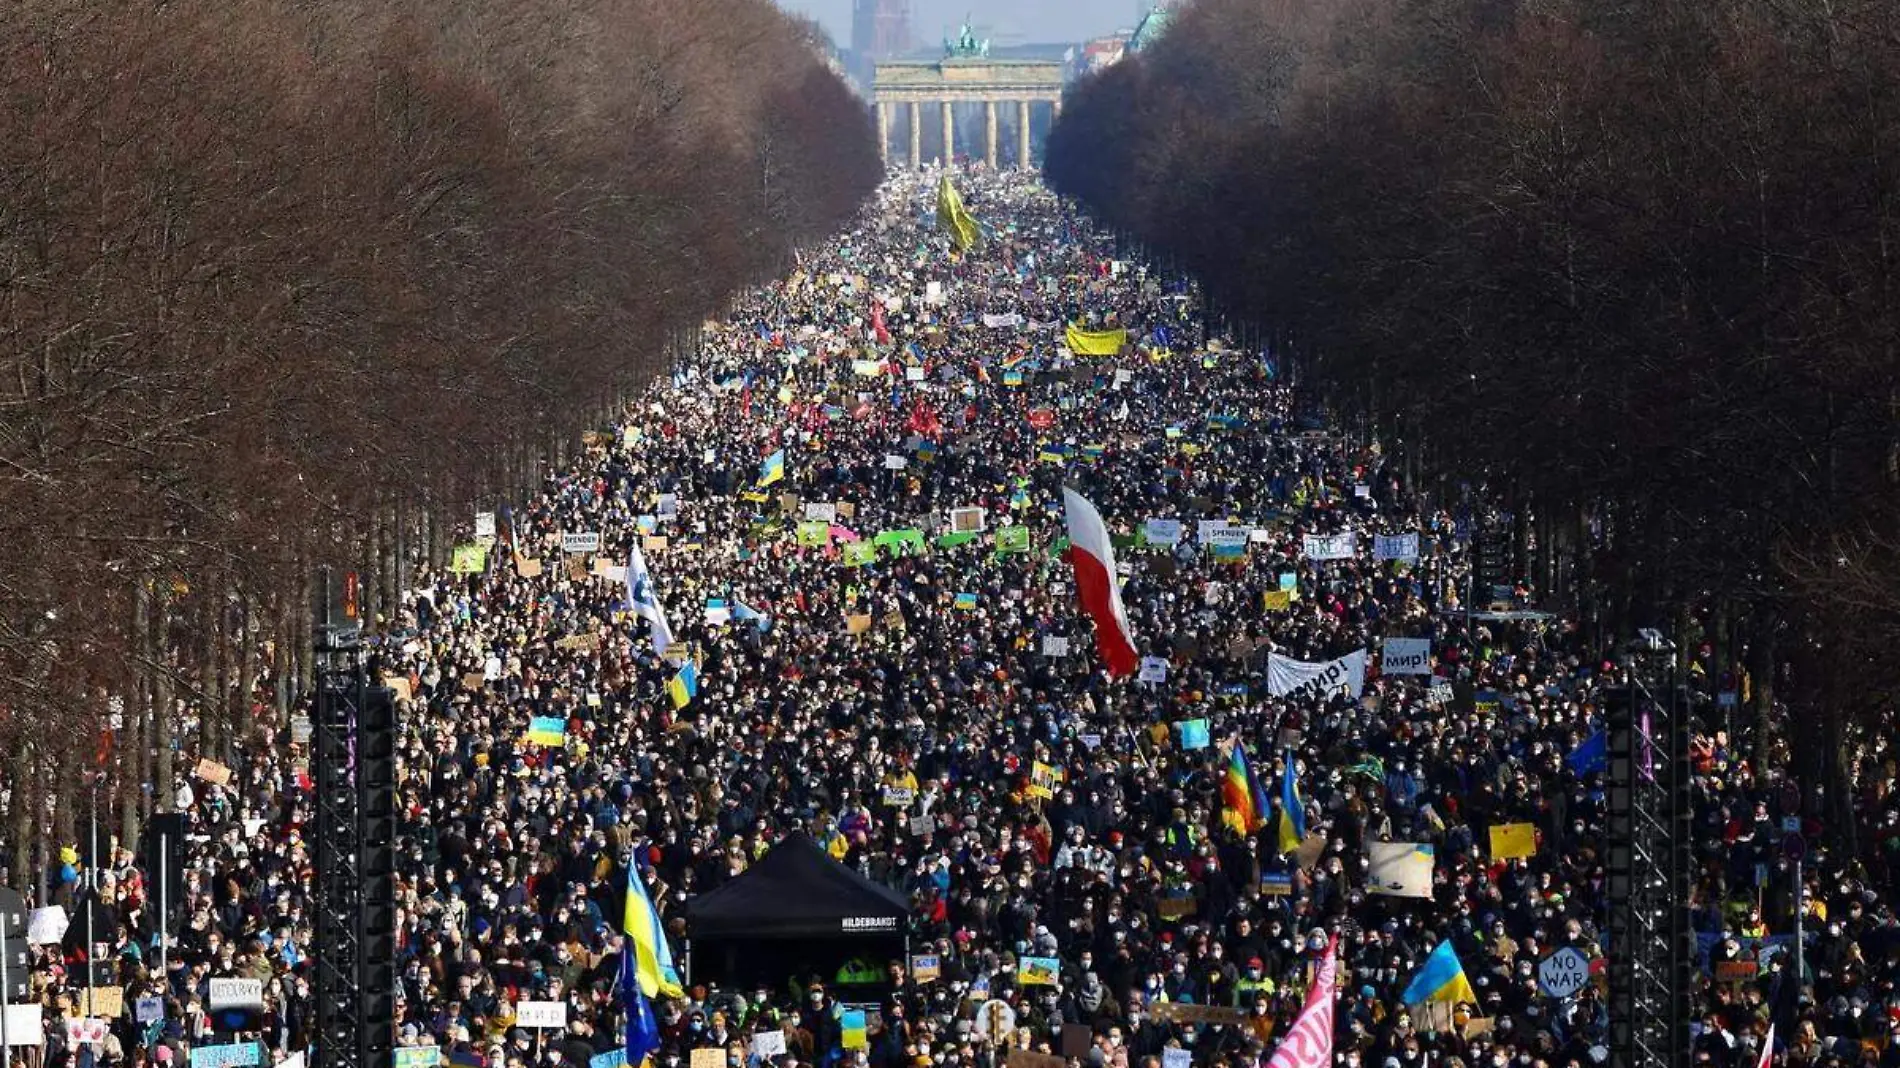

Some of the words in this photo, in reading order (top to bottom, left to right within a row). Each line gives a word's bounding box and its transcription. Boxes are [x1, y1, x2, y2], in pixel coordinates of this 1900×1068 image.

[1386, 651, 1427, 668] мир!
[841, 917, 896, 928] HILDEBRANDT
[1551, 956, 1576, 969] NO
[1543, 972, 1584, 988] WAR
